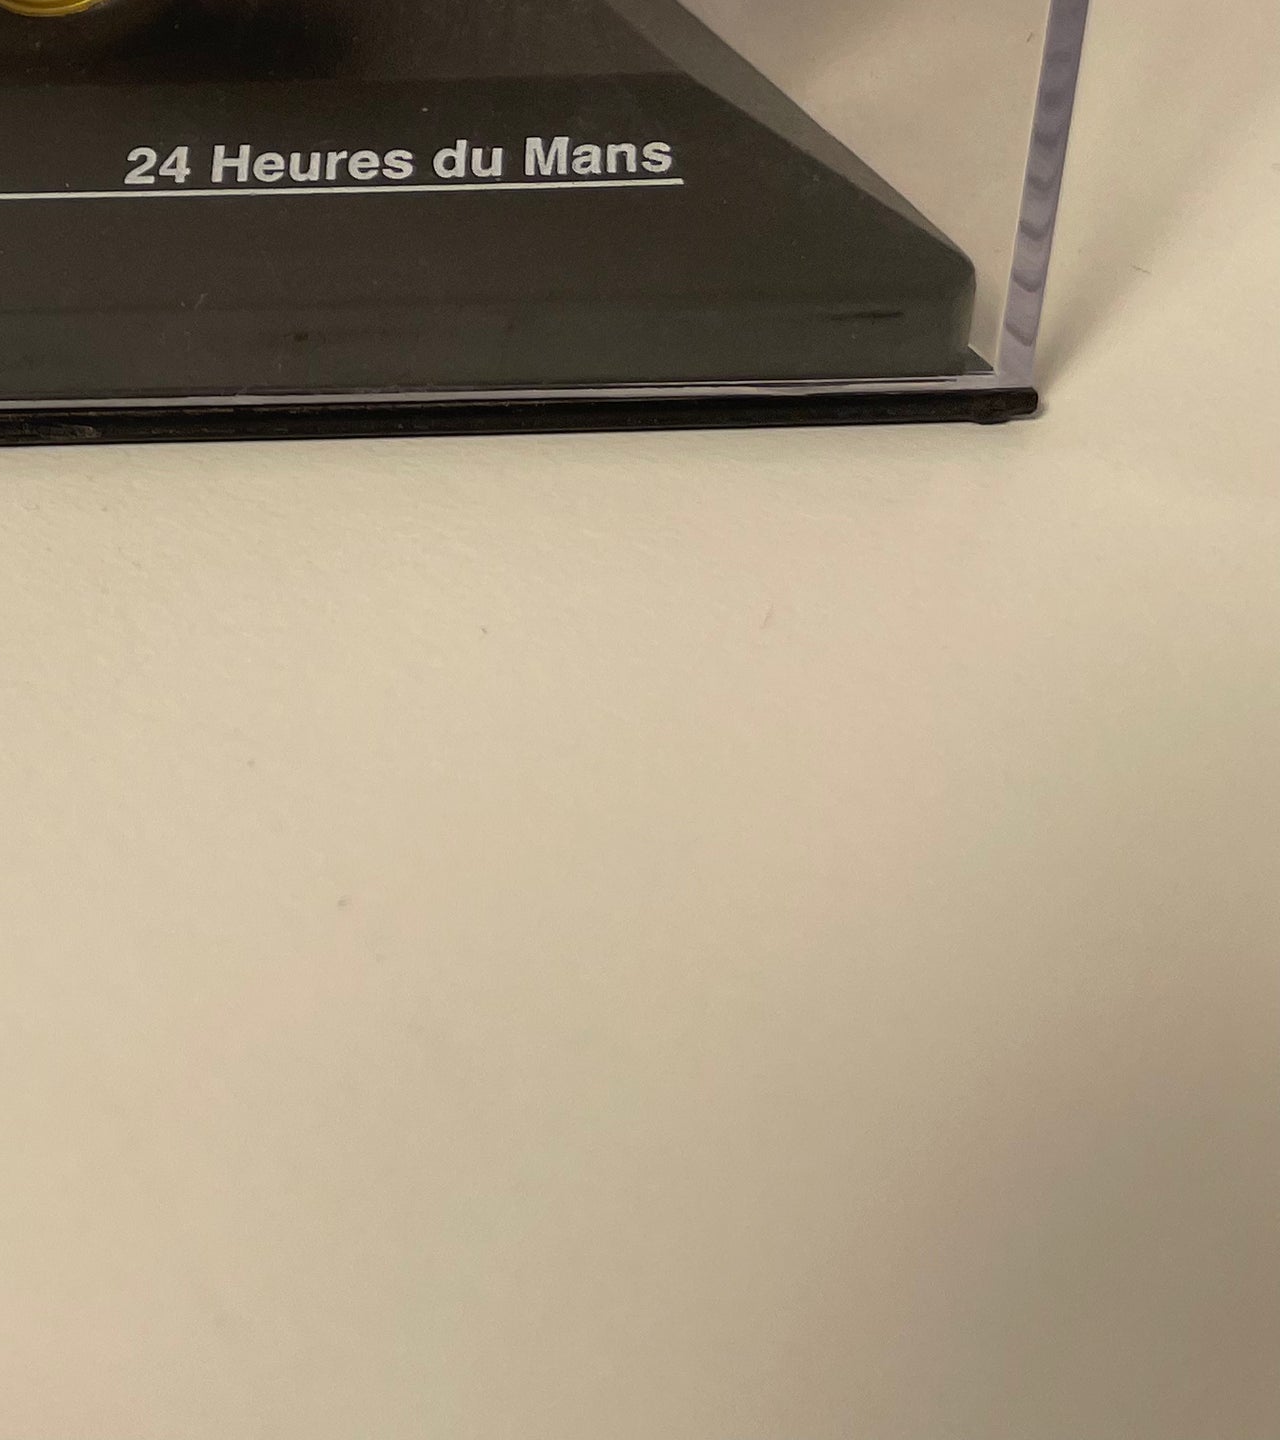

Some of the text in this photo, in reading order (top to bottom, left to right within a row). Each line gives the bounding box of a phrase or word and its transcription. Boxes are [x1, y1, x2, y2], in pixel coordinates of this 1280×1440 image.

[124, 136, 674, 185] 24 Heures du Mans
